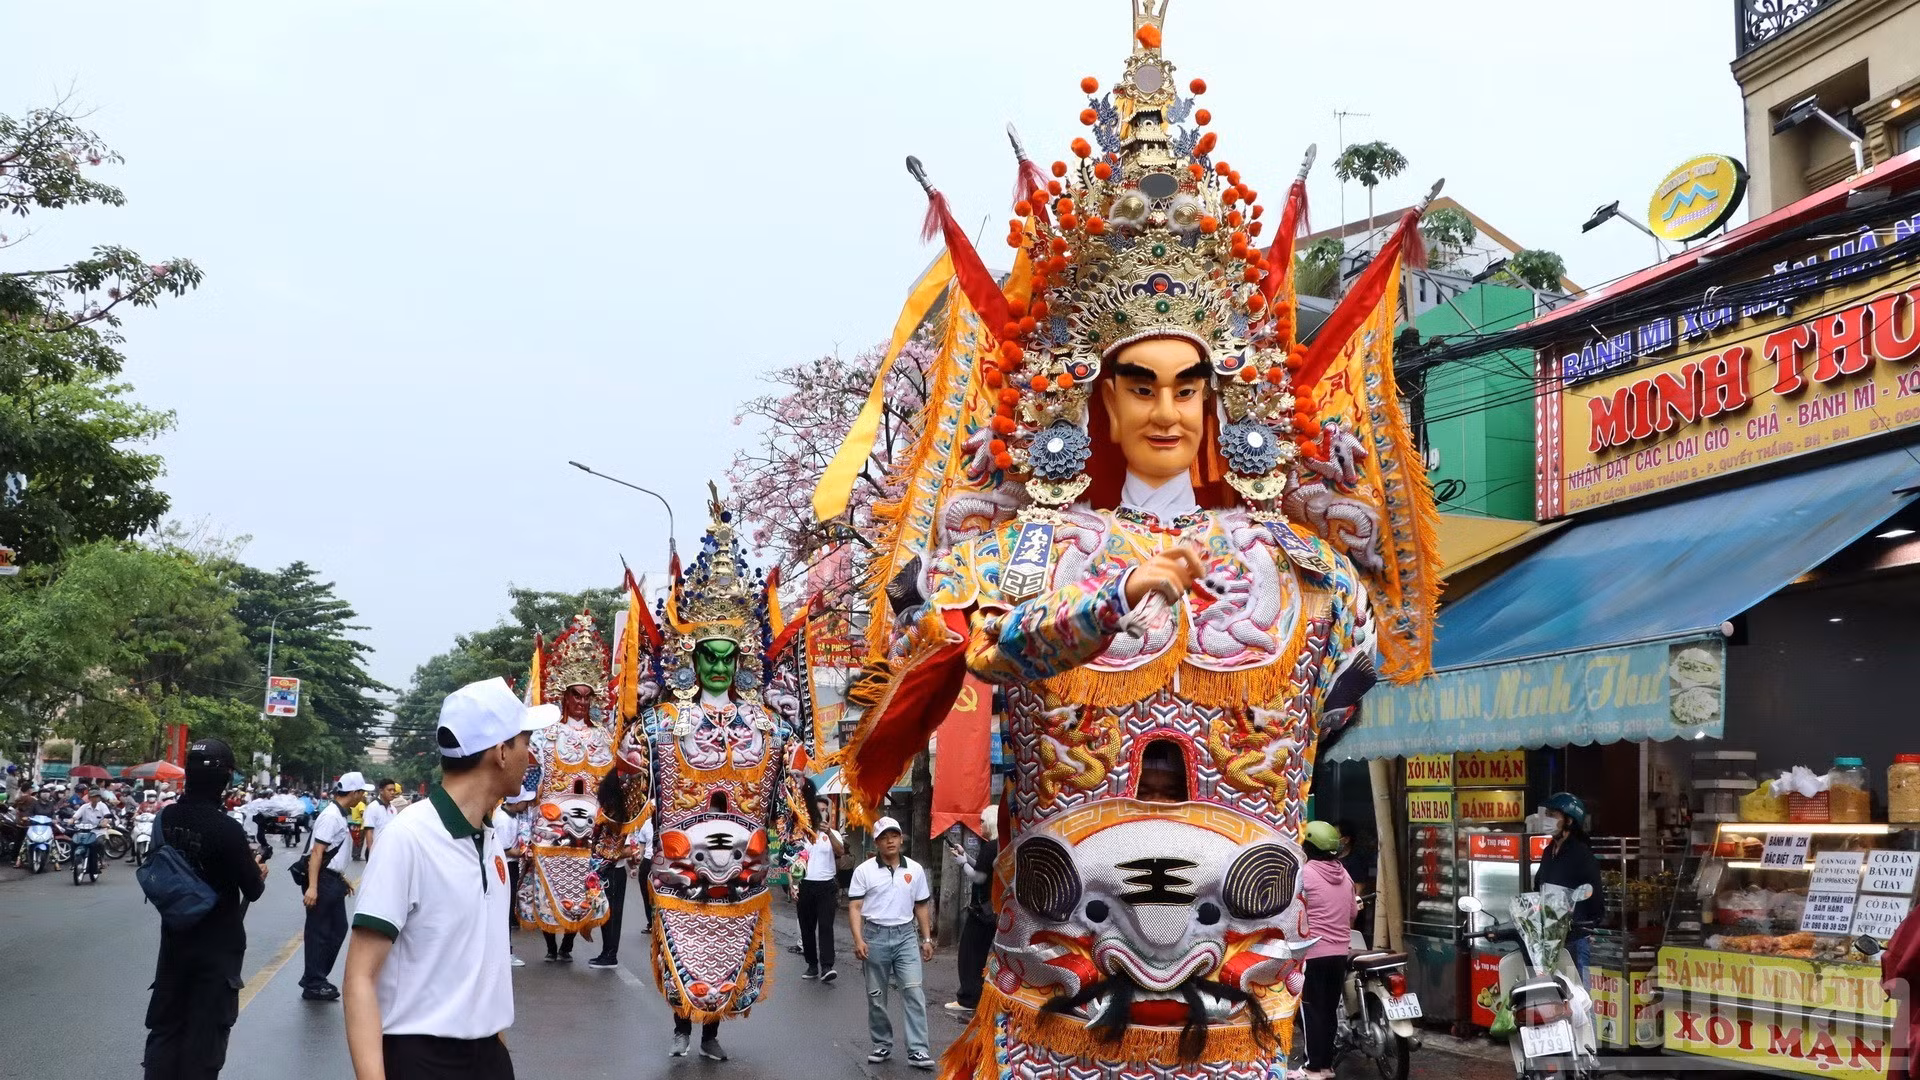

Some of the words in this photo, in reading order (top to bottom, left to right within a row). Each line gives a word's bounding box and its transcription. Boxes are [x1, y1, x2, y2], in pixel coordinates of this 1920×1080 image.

[1587, 346, 1748, 453] MINH
[1568, 462, 1602, 491] NHẬN
[1606, 454, 1631, 482] ĐẶT
[1667, 434, 1700, 464] LOẠI
[1704, 421, 1730, 453] GIÒ
[1746, 404, 1780, 442] CHẢ
[1798, 391, 1847, 428] BÁNH
[1853, 378, 1877, 412] MÌ
[1804, 433, 1821, 448] BH
[1483, 664, 1575, 722] Minh
[1408, 757, 1425, 779] XÔI
[1427, 757, 1450, 783] MẶN
[1458, 755, 1486, 779] XÔI
[1490, 755, 1523, 782] MẶN
[1411, 796, 1432, 819] BÁNH
[1433, 801, 1449, 819] BAO
[1461, 798, 1494, 819] BÁNH
[1496, 801, 1520, 818] BAO
[1768, 835, 1785, 847] BÁNH
[1796, 837, 1808, 848] 22K
[1792, 854, 1805, 865] 27K
[1874, 852, 1890, 863] CÓ
[1891, 852, 1913, 864] BÁN
[1869, 864, 1897, 877] BÁNH
[1900, 866, 1914, 878] MÌ
[1873, 880, 1903, 890] CHAY
[1865, 898, 1880, 908] CÓ
[1881, 898, 1901, 910] BÁN
[1856, 910, 1883, 922] BÁNH
[1666, 951, 1725, 991] BÁNH
[1730, 956, 1756, 996] MÌ
[1762, 967, 1824, 1004] MINH
[1388, 1006, 1419, 1018] 013.16
[1593, 998, 1618, 1018] GIÒ
[1531, 1038, 1563, 1054] 1799
[1673, 1008, 1755, 1051] XÔI
[1767, 1021, 1886, 1073] MẶN
